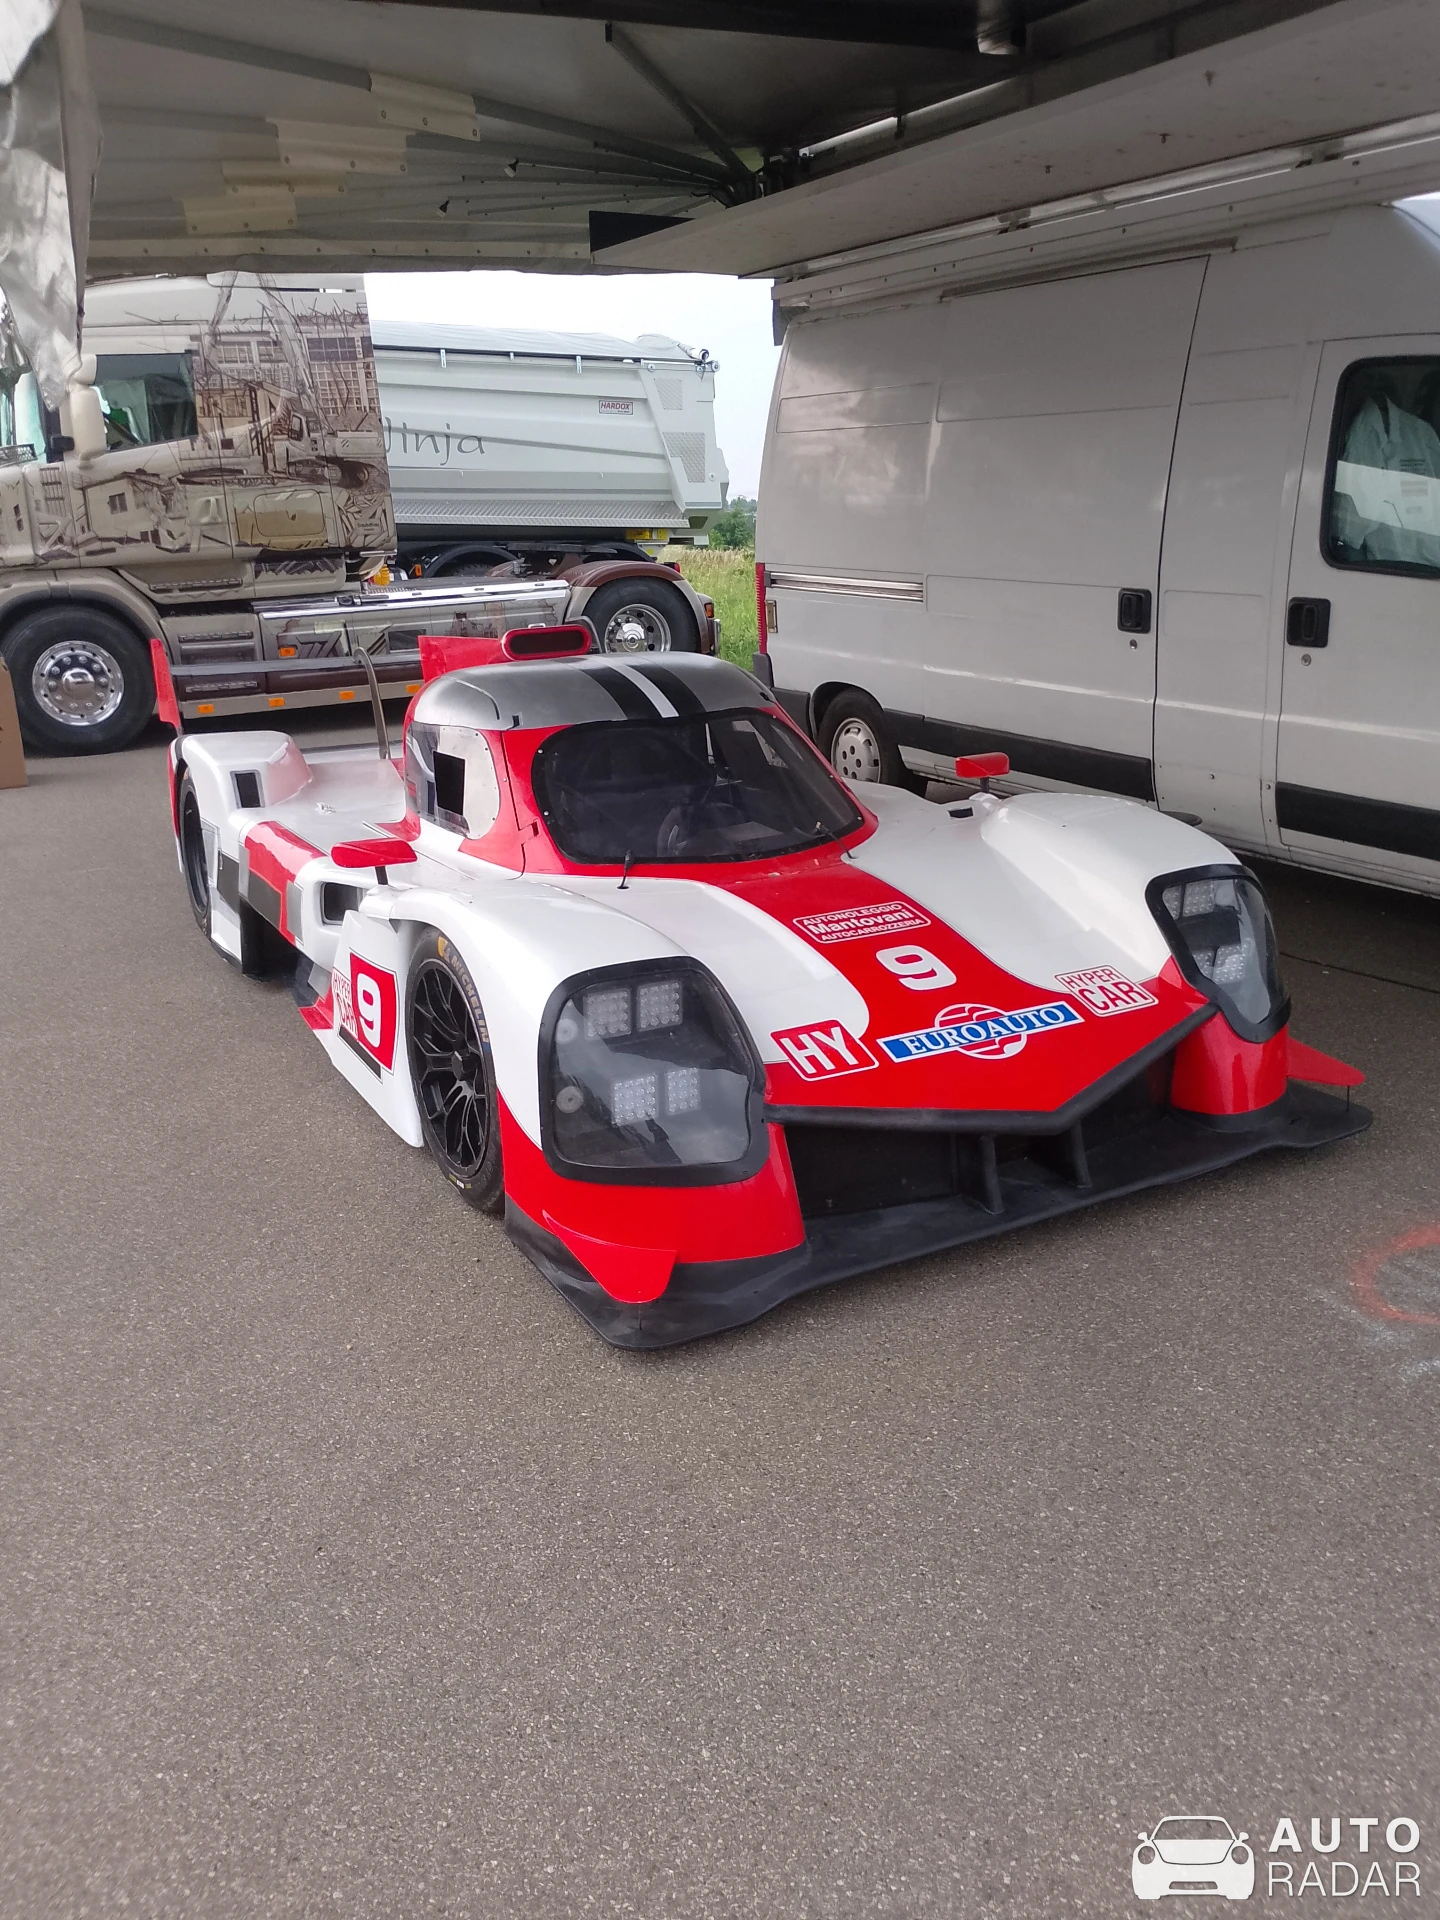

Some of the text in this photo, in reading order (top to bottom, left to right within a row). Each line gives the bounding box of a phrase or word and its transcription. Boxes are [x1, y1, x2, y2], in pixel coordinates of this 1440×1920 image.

[601, 402, 631, 410] HARDOX
[803, 903, 902, 926] AUTONOLEGGIO
[807, 909, 914, 934] Mantovani
[821, 918, 924, 941] AUTOCARROZZERIA
[876, 945, 957, 991] 9
[1062, 968, 1121, 989] HYPER
[356, 972, 381, 1048] 9
[450, 955, 490, 1043] MICHELIN
[1078, 981, 1150, 1011] CAR
[900, 1007, 1066, 1055] EUROAUTO
[780, 1026, 859, 1074] HY
